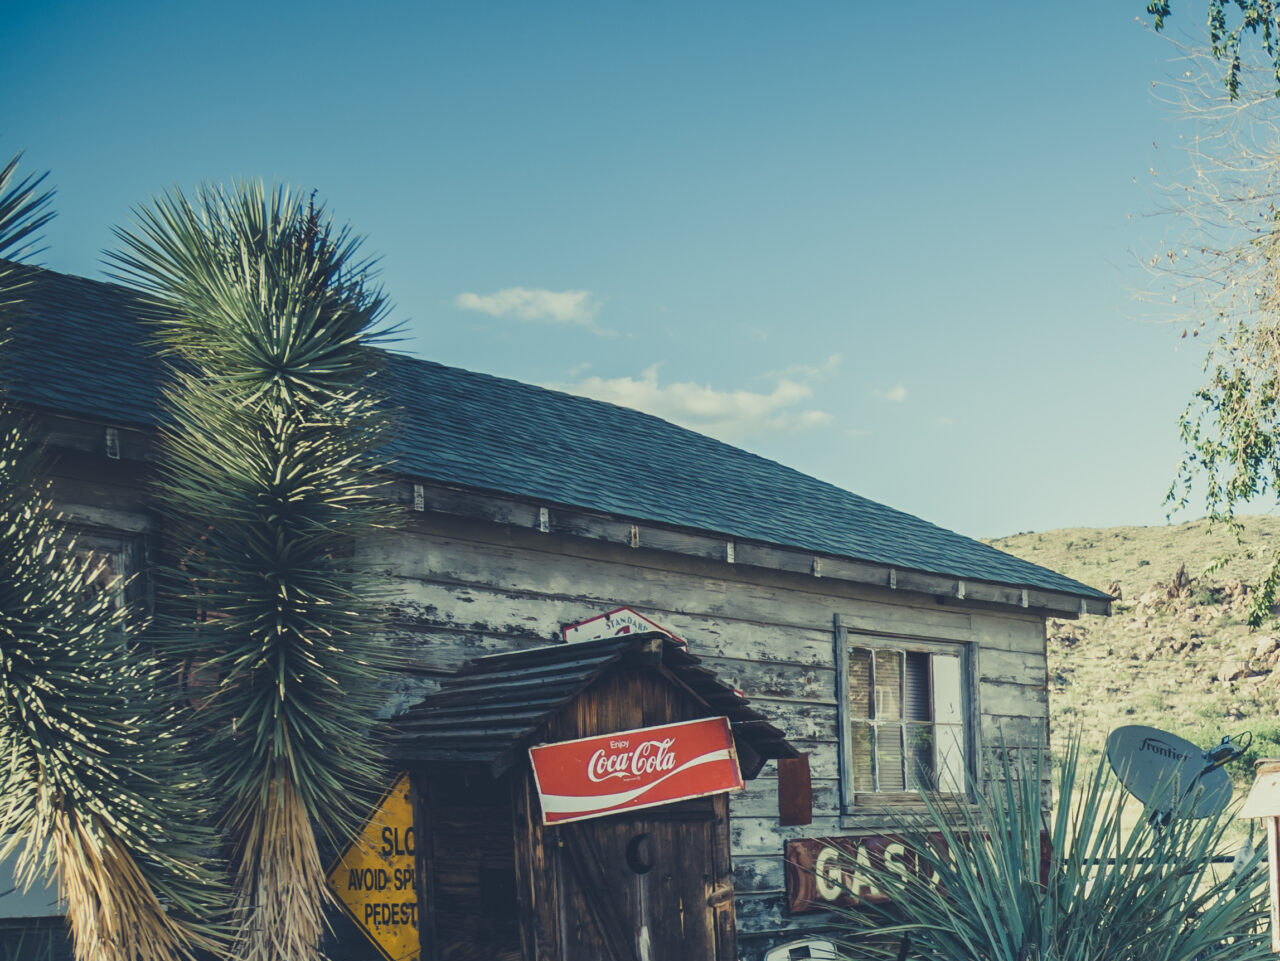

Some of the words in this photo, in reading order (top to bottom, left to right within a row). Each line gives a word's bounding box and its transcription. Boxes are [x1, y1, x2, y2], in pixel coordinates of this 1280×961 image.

[610, 740, 630, 749] Enjoy
[588, 737, 676, 782] Coca-Cola
[381, 826, 415, 857] SLO
[348, 868, 387, 891] AVOID
